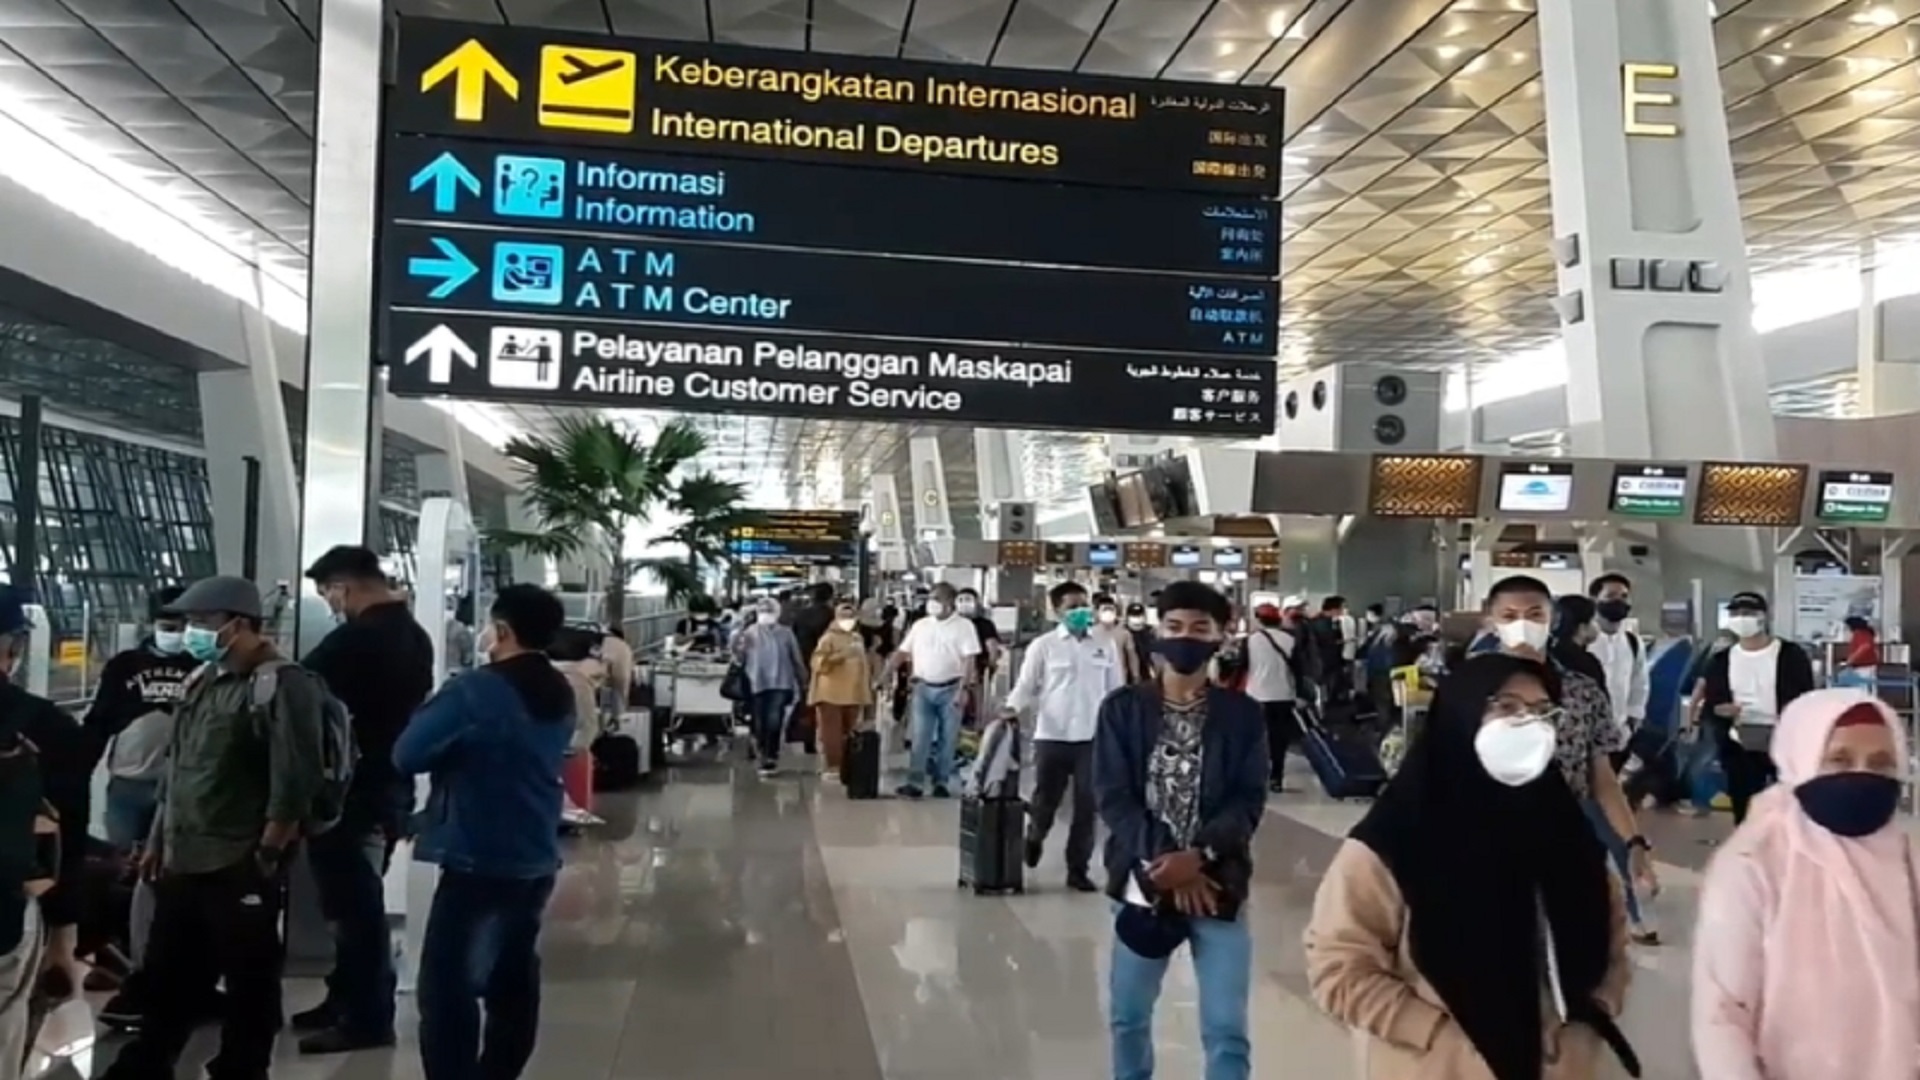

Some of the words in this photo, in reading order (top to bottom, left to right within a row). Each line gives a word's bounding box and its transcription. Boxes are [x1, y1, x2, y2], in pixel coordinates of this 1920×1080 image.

[654, 54, 914, 102] Keberangkatan
[926, 77, 1136, 119] Internasional
[1621, 62, 1679, 137] E
[651, 107, 865, 151] International
[876, 125, 1059, 166] Departures
[576, 160, 726, 195] Informasi
[575, 196, 755, 232] Information
[683, 286, 792, 319] Center
[573, 330, 743, 367] Pelayanan
[754, 341, 919, 379] Pelanggan
[929, 351, 1072, 389] Maskapai
[573, 366, 675, 397] Airline
[684, 372, 840, 406] Customer
[848, 380, 962, 411] Service
